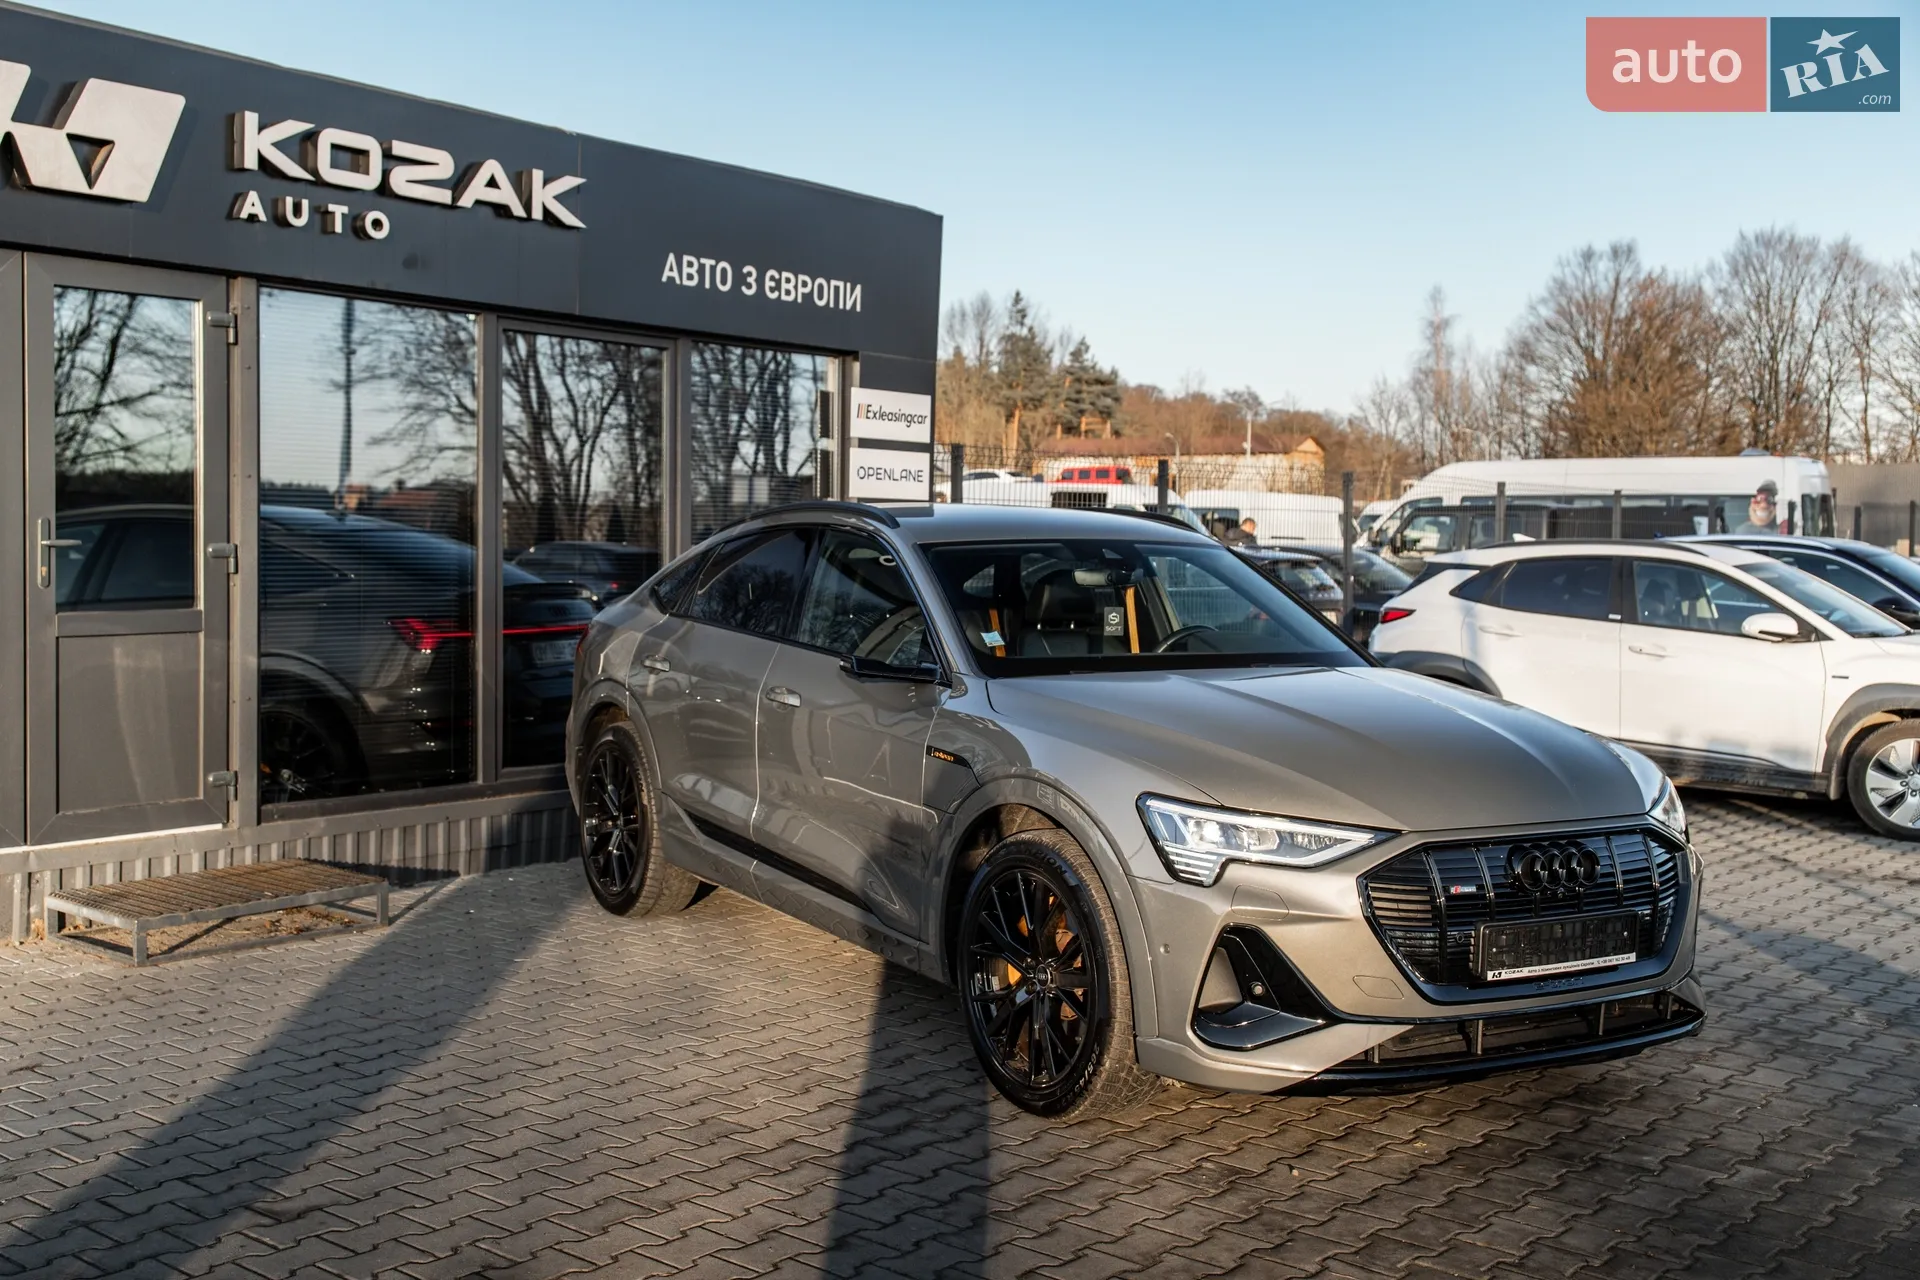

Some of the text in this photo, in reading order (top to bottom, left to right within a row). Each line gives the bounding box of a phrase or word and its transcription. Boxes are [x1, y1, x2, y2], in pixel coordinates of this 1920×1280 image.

[233, 110, 587, 229] KOZAK
[236, 190, 391, 240] AUTO
[661, 252, 733, 292] АВТО
[764, 269, 862, 312] ЄВРОПИ
[865, 403, 928, 428] Exleasingcar
[856, 465, 924, 483] OPENLANE
